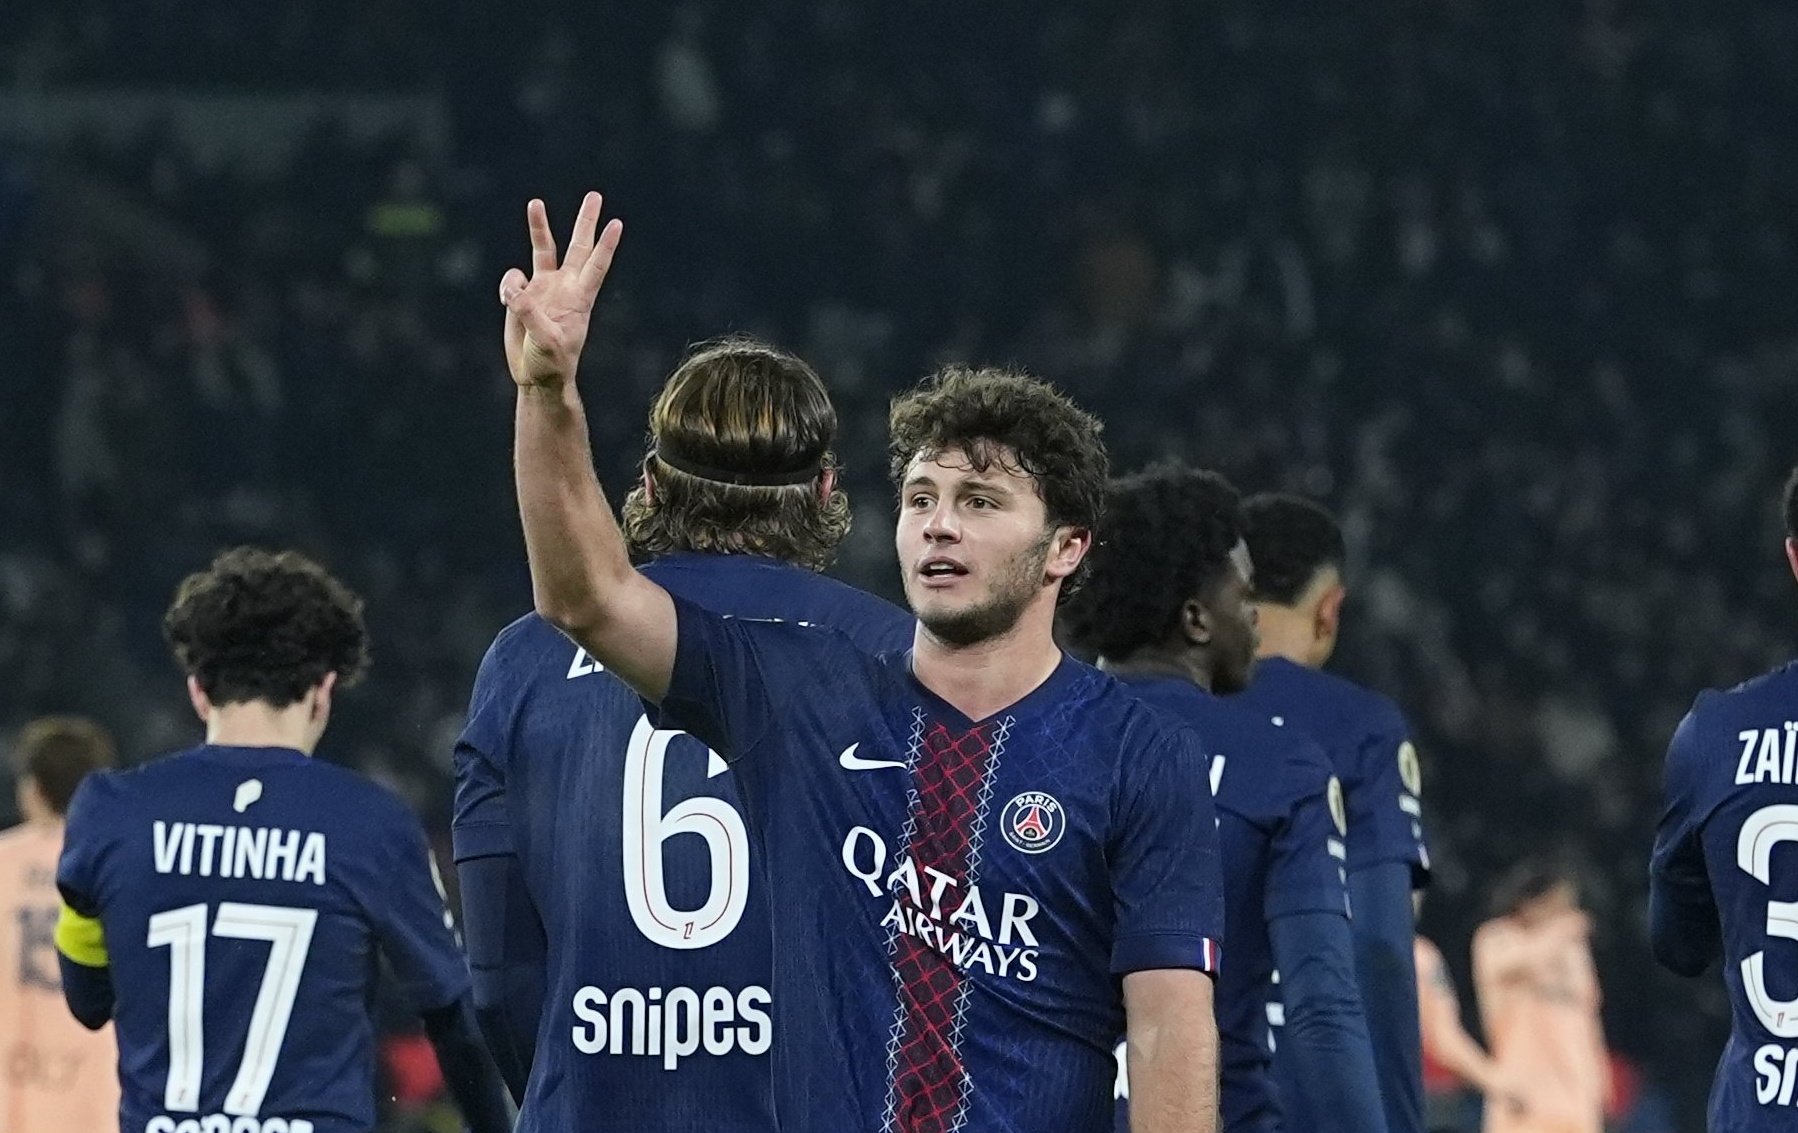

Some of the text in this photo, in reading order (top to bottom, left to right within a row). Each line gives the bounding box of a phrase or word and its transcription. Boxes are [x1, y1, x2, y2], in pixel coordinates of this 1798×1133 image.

[1735, 721, 1798, 785] ZAÏ
[622, 713, 750, 950] 6
[1015, 795, 1057, 812] PARIS
[153, 821, 326, 885] VITINHA
[842, 826, 1039, 946] QATAR
[880, 900, 1039, 982] AIRWAYS
[147, 901, 319, 1117] 17
[572, 985, 773, 1071] snipes
